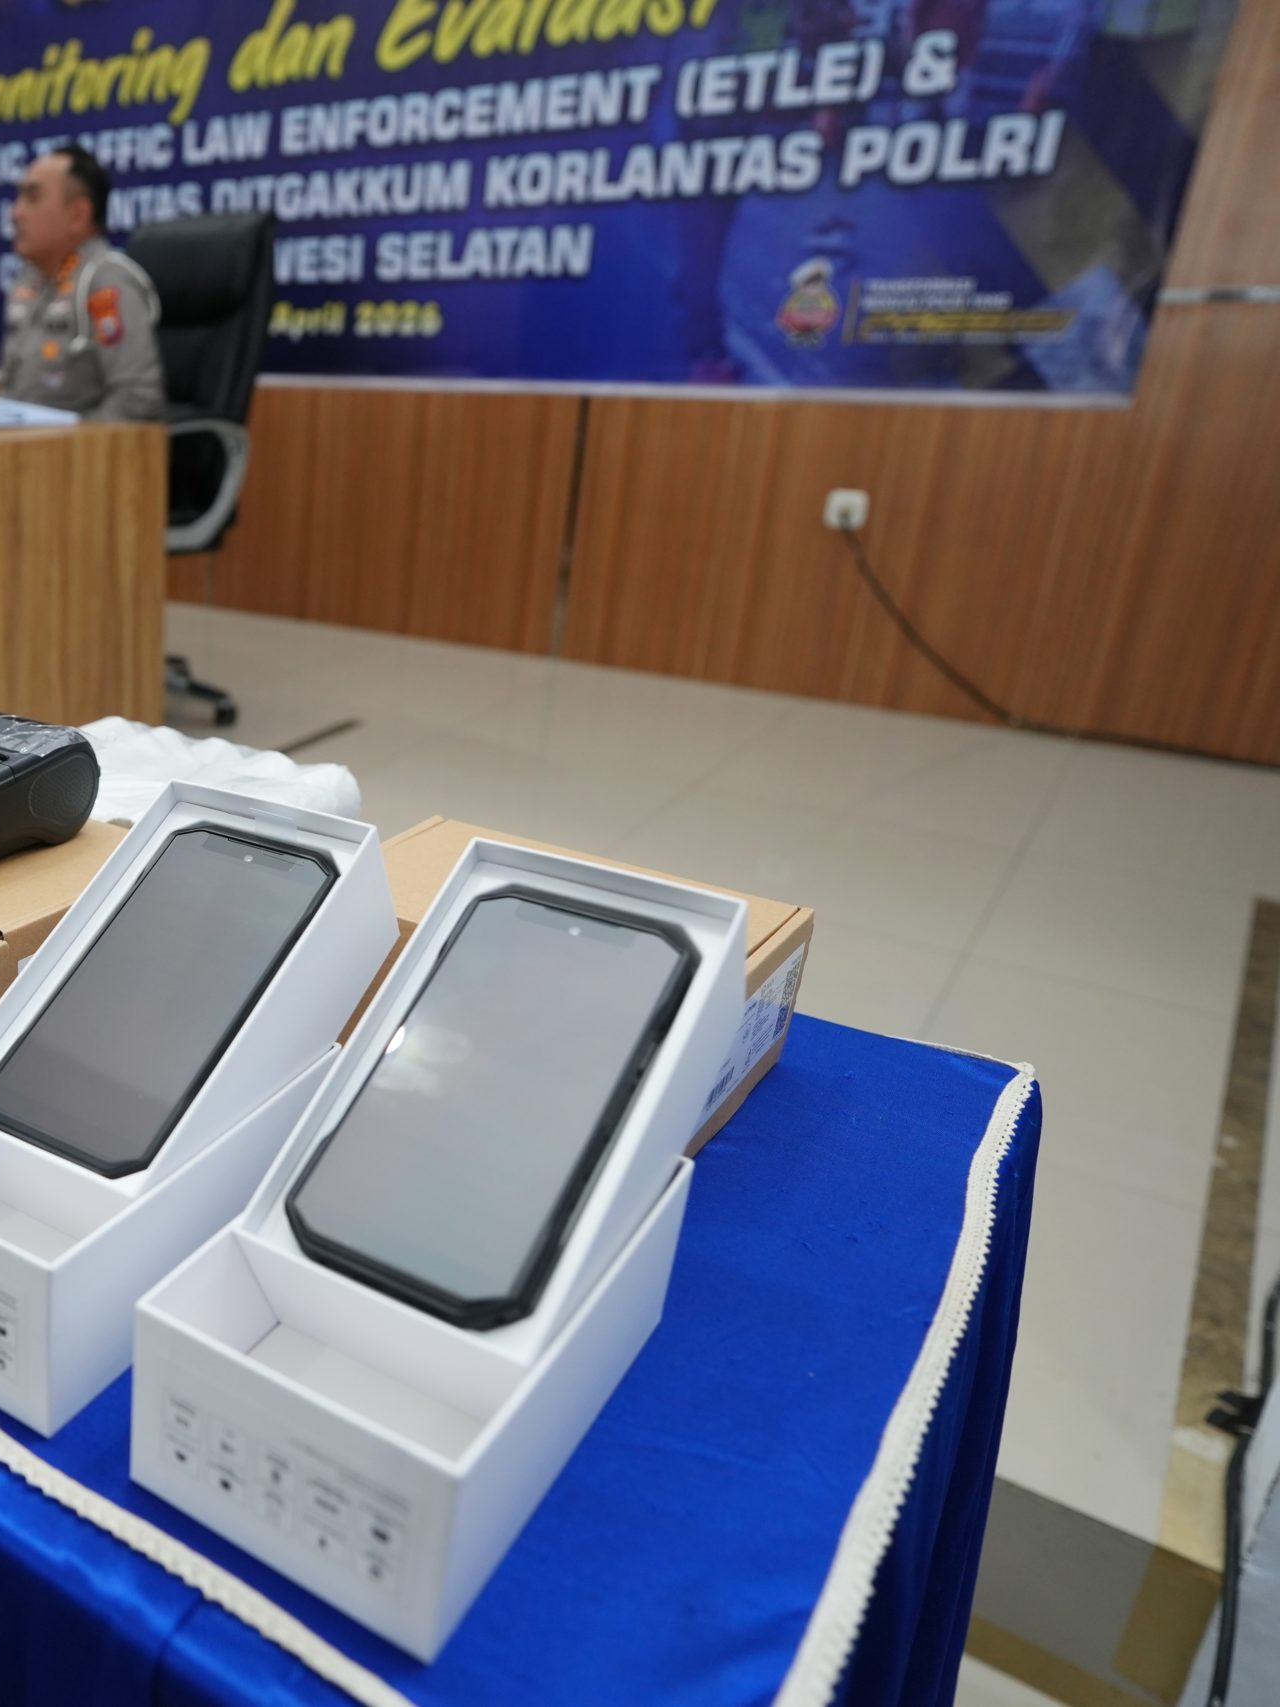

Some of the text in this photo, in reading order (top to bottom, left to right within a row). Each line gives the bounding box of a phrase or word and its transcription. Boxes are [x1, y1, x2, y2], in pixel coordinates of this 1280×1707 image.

[228, 0, 355, 92] dan
[182, 111, 272, 167] LAW
[279, 65, 661, 156] ENFORCEMENT
[677, 39, 883, 117] (ETLE)
[905, 30, 958, 95] &
[212, 158, 473, 222] DITGAKKUM
[484, 130, 824, 208] KORLANTAS
[841, 110, 1065, 188] POLRI
[376, 224, 594, 281] SELATAN
[268, 301, 347, 341] April
